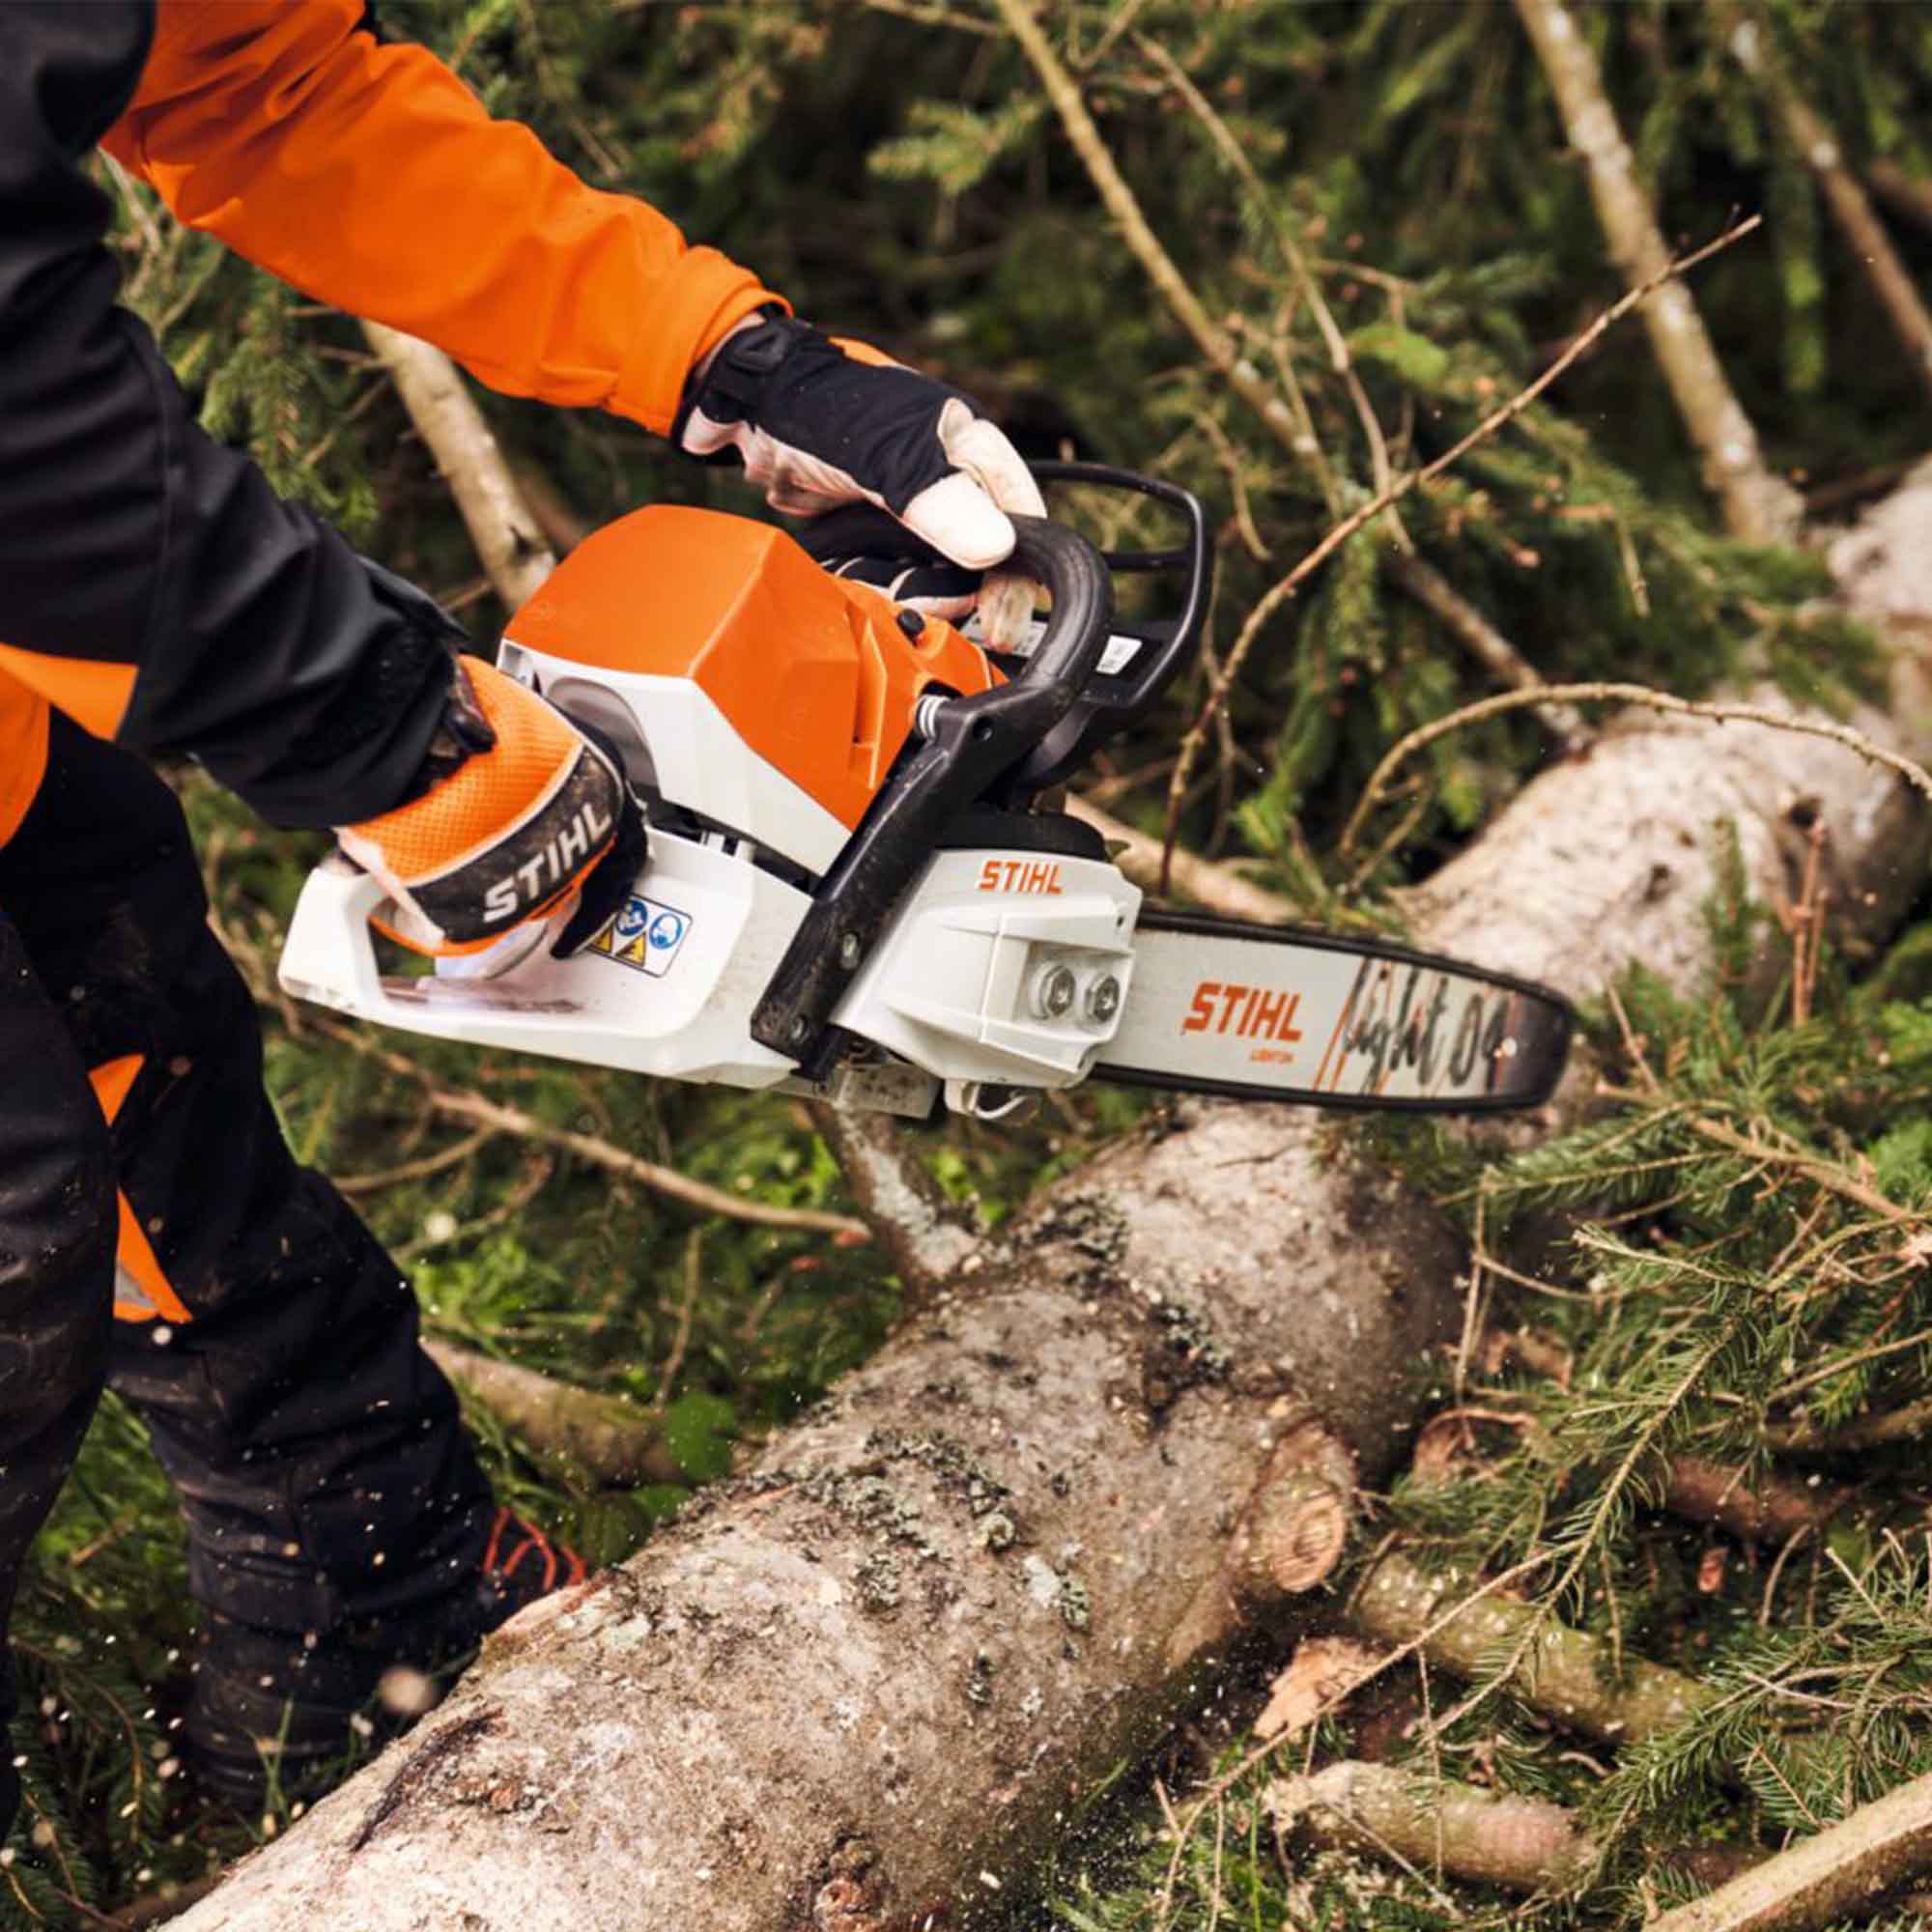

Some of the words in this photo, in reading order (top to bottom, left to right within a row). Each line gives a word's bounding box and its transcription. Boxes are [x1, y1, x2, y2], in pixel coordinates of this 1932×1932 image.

[484, 804, 611, 923] STIHL
[978, 860, 1063, 895] STIHL
[1184, 982, 1302, 1041] STIHL
